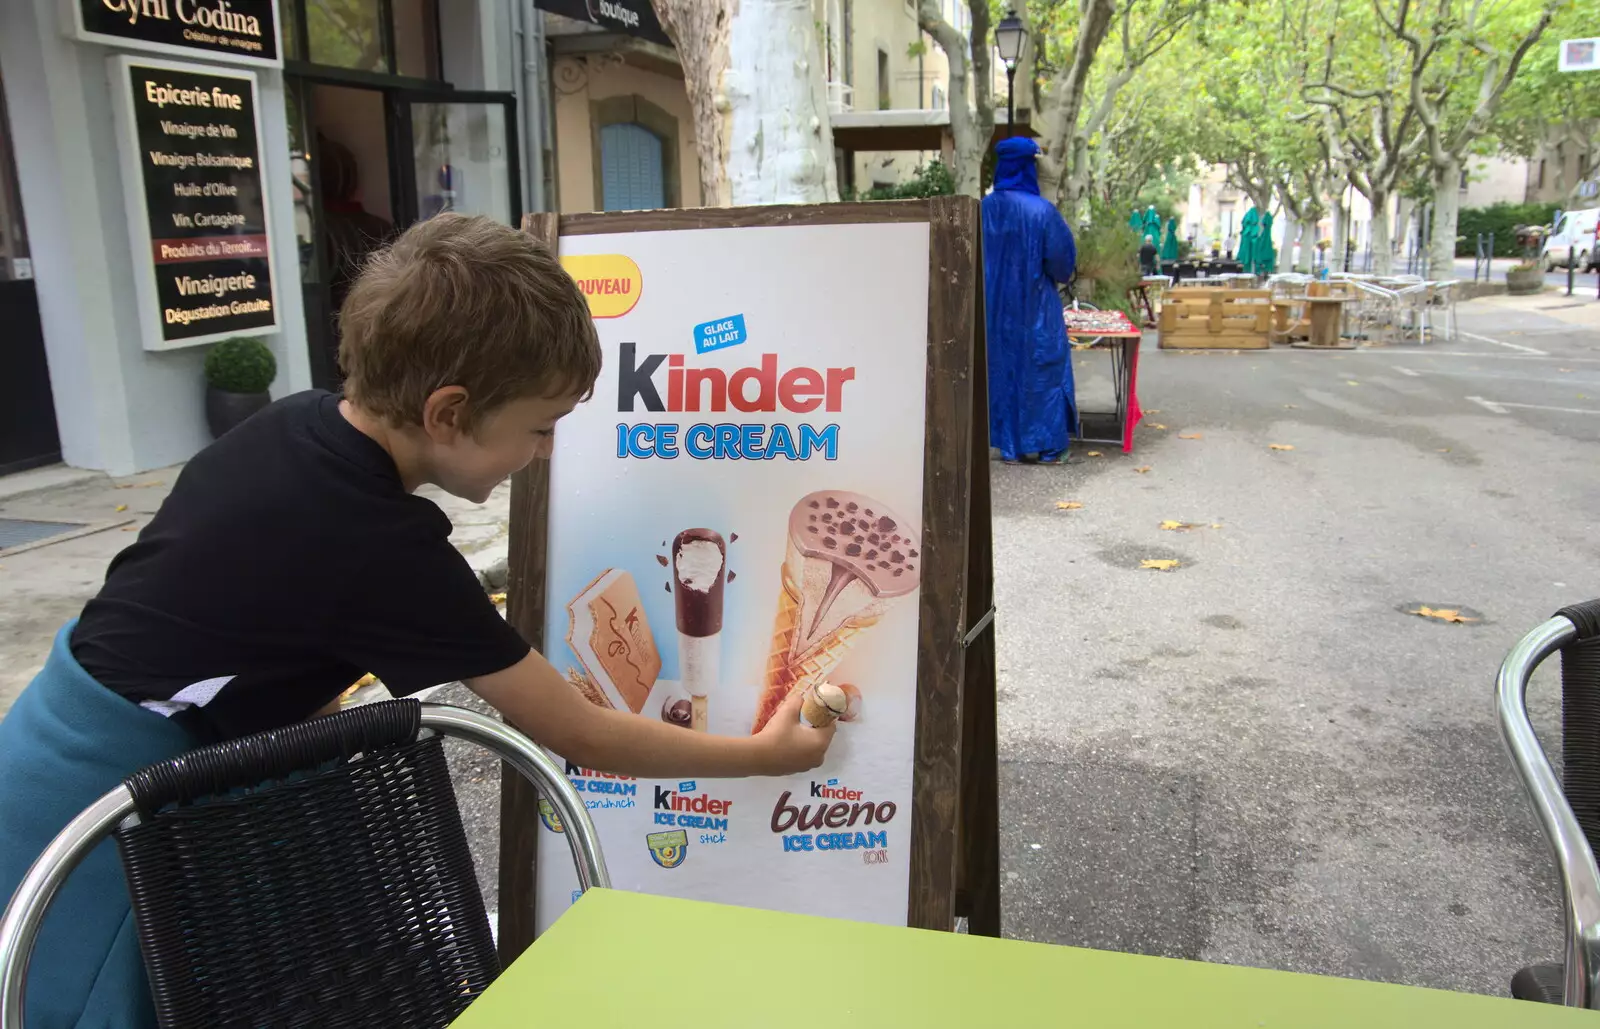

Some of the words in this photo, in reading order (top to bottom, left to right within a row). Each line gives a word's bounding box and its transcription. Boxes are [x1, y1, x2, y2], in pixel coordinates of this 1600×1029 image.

[175, 0, 262, 37] Codina
[145, 80, 211, 108] Epicerie
[212, 87, 242, 110] fine
[160, 120, 205, 139] Vinaigre
[206, 123, 219, 138] de
[219, 124, 238, 138] Vin
[149, 151, 196, 170] Vinaigre
[196, 152, 253, 170] Balsamique
[174, 182, 202, 196] Huile
[203, 182, 238, 197] d'Olive
[172, 213, 194, 228] Vin,
[194, 212, 246, 229] Cartagène
[161, 243, 205, 259] Produits
[206, 242, 220, 255] du
[174, 270, 257, 297] Vinaigrerie
[576, 278, 631, 295] OUVEAU
[165, 303, 230, 325] Dégustation
[230, 298, 271, 316] Gratuite
[704, 320, 734, 335] GLACE
[703, 336, 717, 347] AU
[719, 330, 739, 344] LAIT
[616, 422, 680, 460] ICE
[684, 422, 840, 461] CREAM
[587, 780, 637, 797] CREAM
[585, 797, 636, 810] sandwich
[770, 790, 897, 833] bueno
[653, 812, 676, 826] ICE
[677, 814, 729, 831] CREAM
[700, 832, 727, 844] stick
[782, 834, 815, 852] ICE
[815, 830, 888, 851] CREAM
